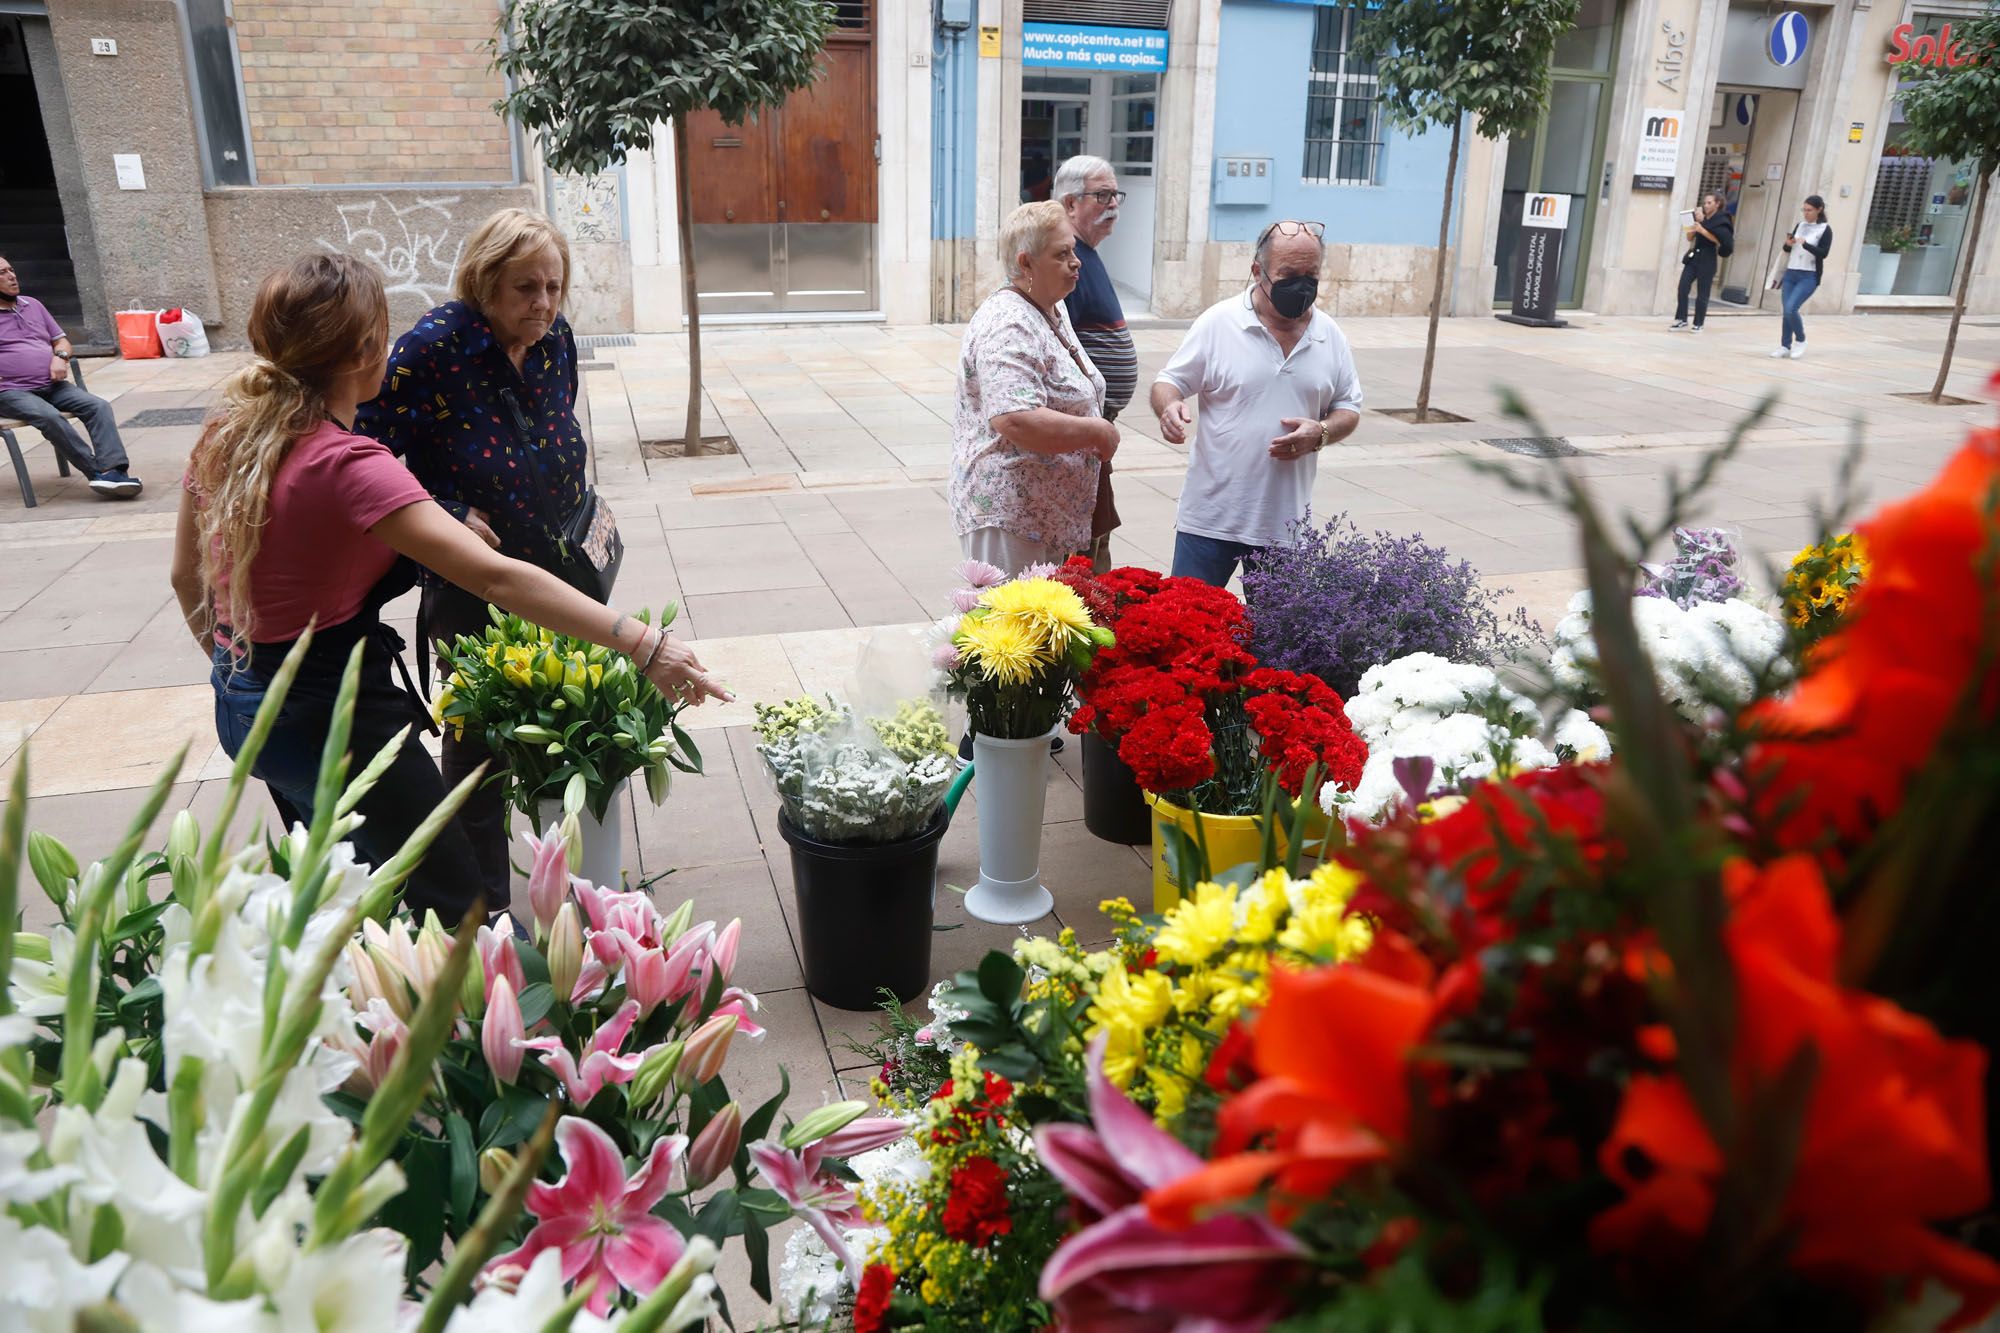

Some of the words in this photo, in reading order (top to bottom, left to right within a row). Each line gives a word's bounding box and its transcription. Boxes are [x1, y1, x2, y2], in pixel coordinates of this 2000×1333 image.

[1024, 31, 1144, 48] www.copicentro.net
[1023, 46, 1063, 60] Mucho
[1066, 47, 1091, 62] más
[1094, 52, 1116, 65] que
[1527, 232, 1538, 270] DENTAL
[1533, 233, 1546, 302] MAXILOFACIAL
